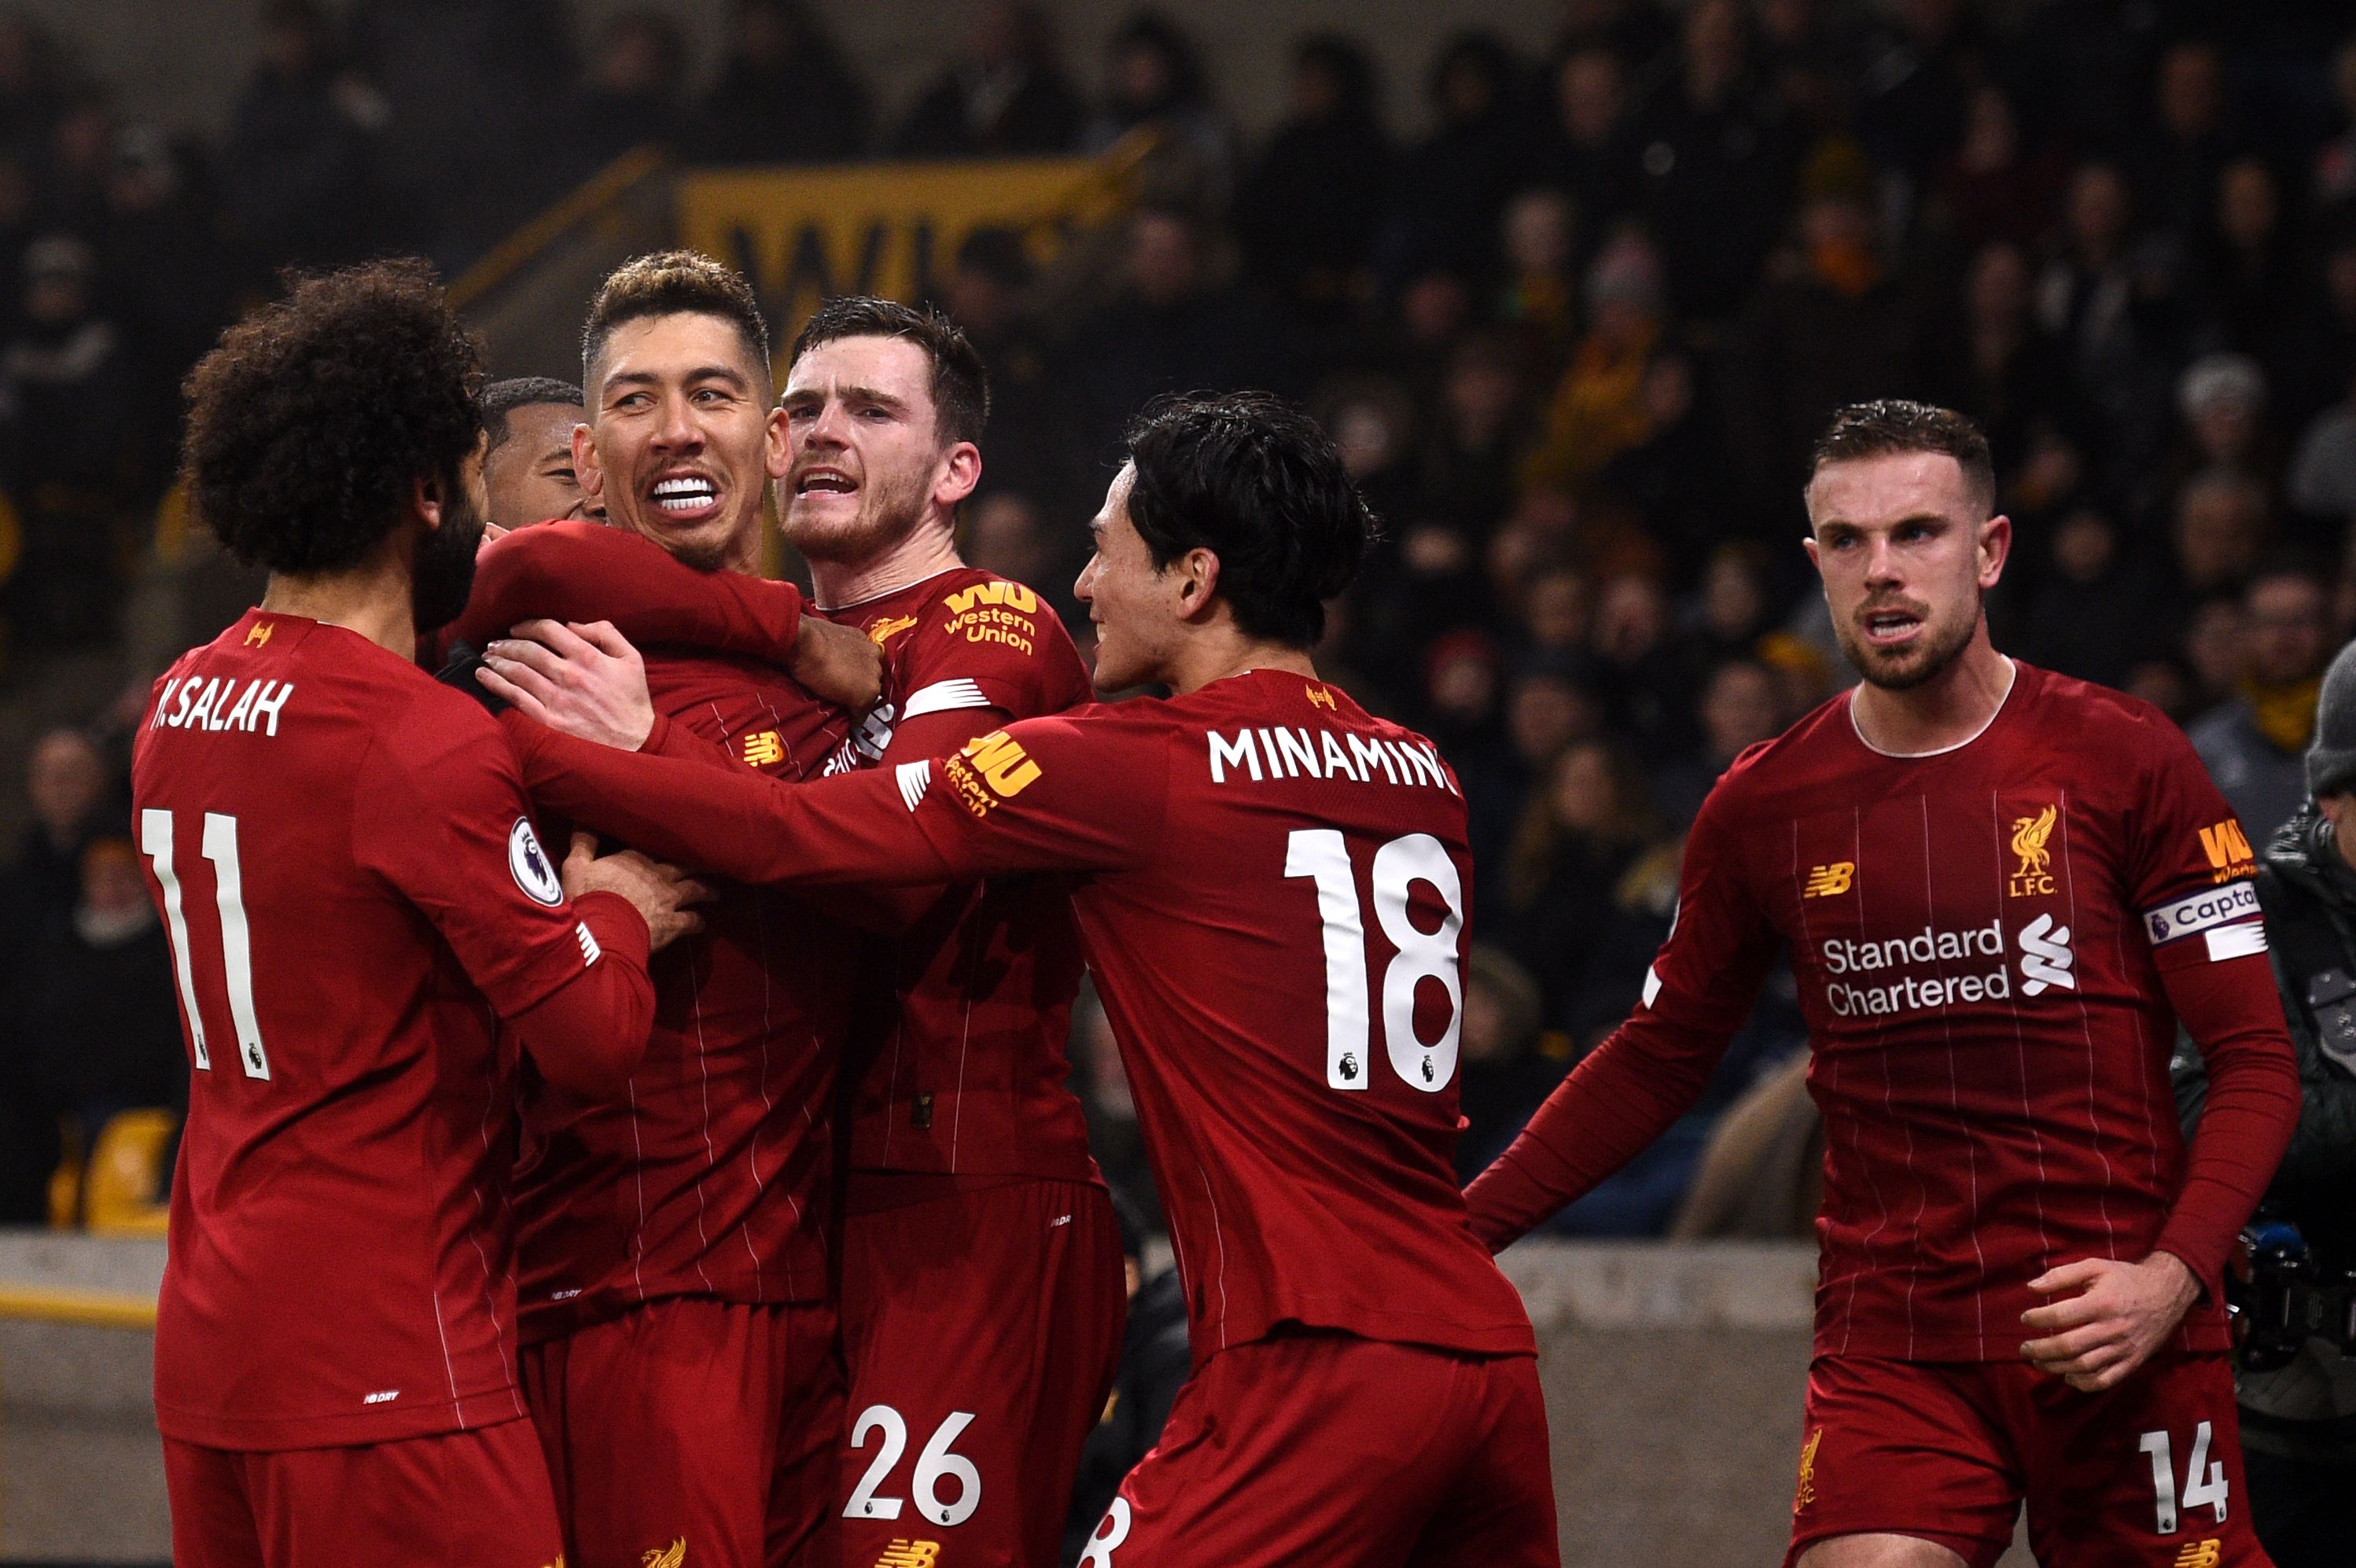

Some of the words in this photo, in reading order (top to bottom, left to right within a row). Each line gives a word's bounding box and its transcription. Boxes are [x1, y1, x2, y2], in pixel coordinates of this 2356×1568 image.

[944, 608, 1035, 637] Western
[966, 624, 1033, 656] Union
[2175, 885, 2257, 926] Capta
[142, 808, 270, 1081] 11
[1284, 829, 1463, 1092] 18
[1824, 918, 2004, 974] Standard
[1828, 964, 2010, 1016] Chartered
[841, 1404, 981, 1526] 26
[2140, 1421, 2229, 1534] 14
